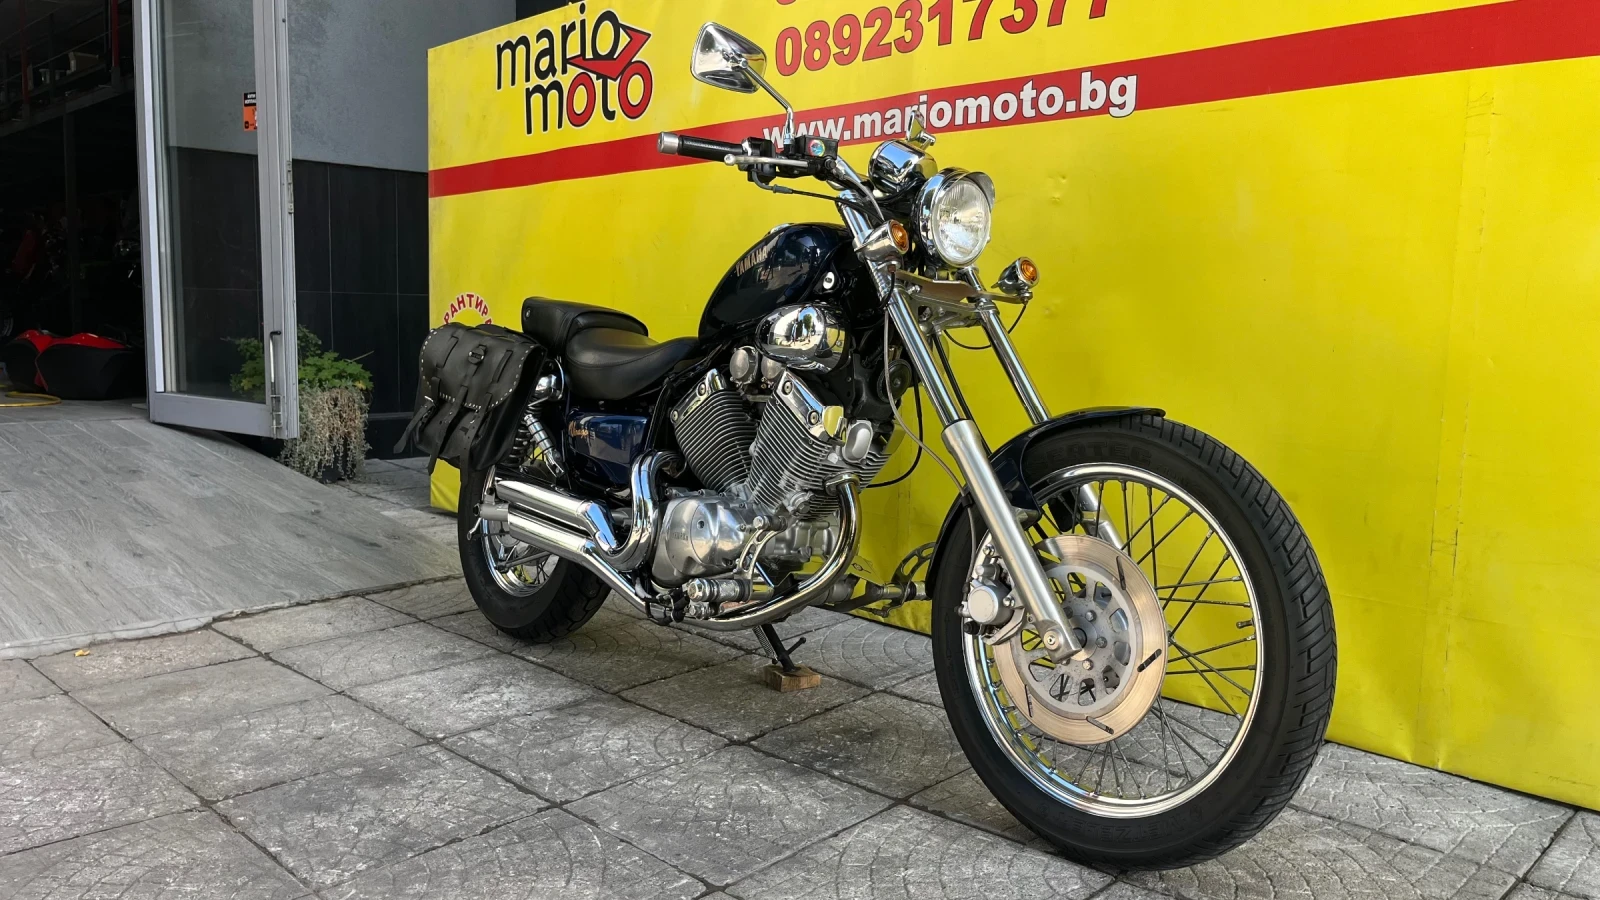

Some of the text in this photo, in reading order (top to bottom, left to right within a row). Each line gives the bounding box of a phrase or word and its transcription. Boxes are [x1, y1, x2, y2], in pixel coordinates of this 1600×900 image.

[496, 2, 621, 90] mario
[525, 61, 653, 135] moto
[735, 245, 768, 277] YAMAHA
